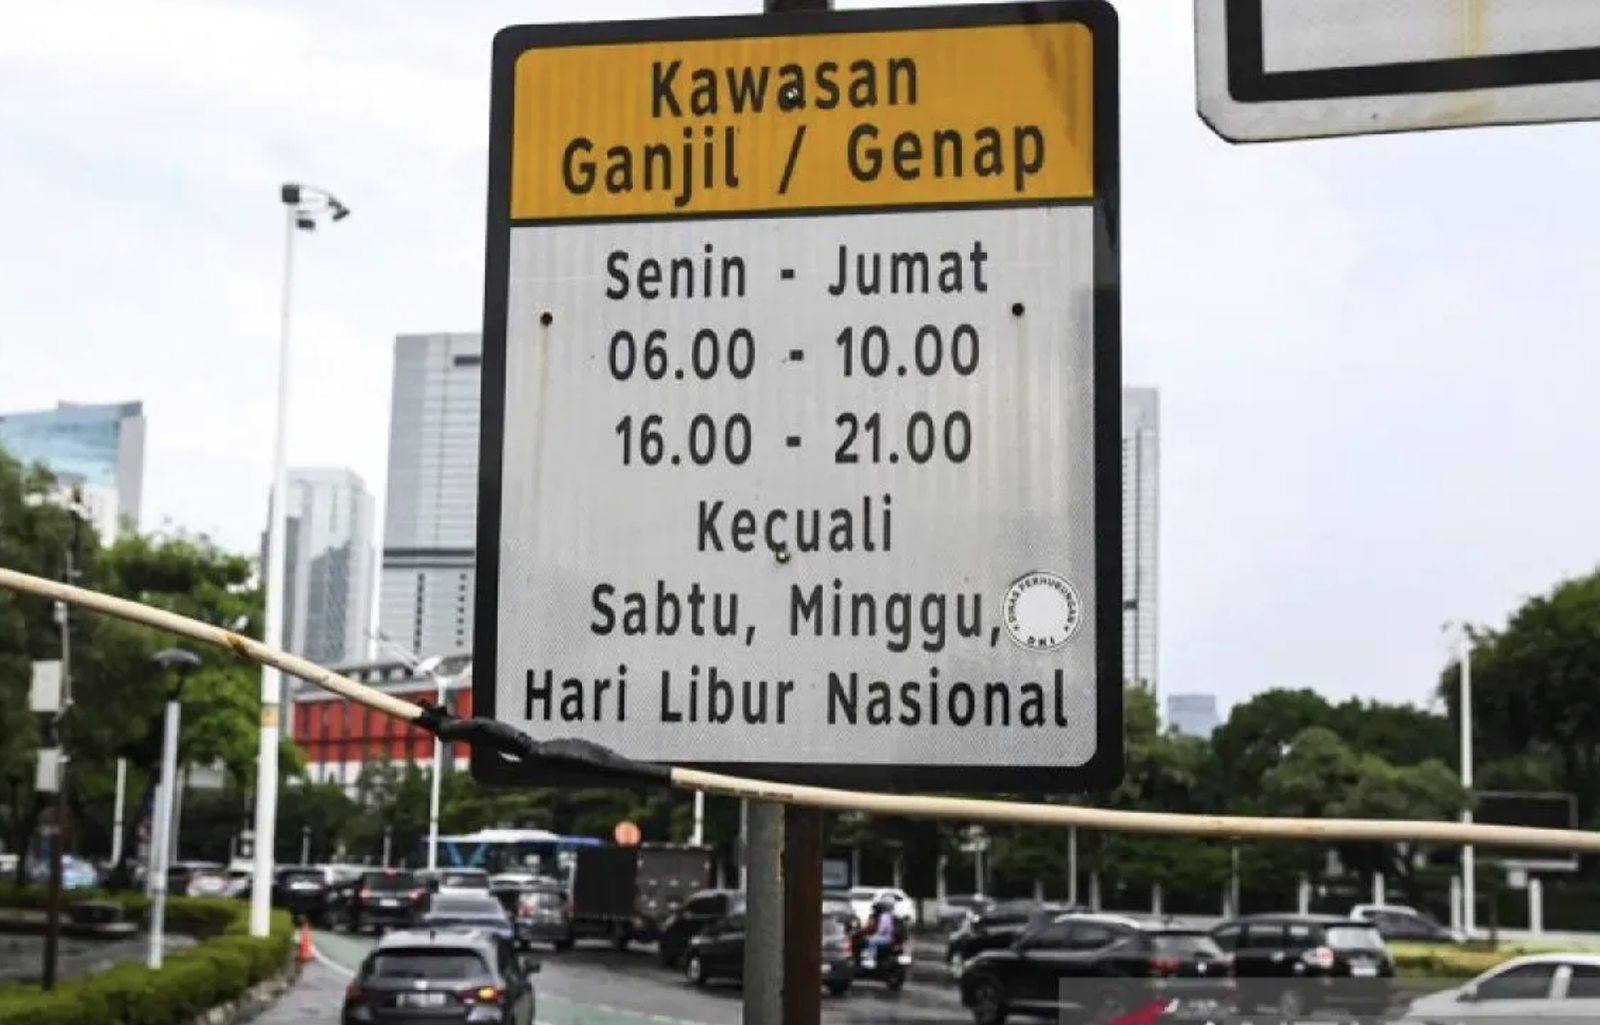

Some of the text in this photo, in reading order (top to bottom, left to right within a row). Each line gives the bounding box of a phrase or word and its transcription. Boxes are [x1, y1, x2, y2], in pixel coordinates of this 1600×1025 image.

[651, 57, 917, 118] Kawasan
[562, 122, 1045, 207] Ganjil / Genap
[606, 241, 988, 300] Senin - Jumat
[609, 324, 980, 381] 06.00 - 10.00
[616, 411, 972, 465] 16.00 - 21.00
[698, 493, 892, 553] Kecuali
[590, 578, 1001, 653] Sabtu, Minggu,
[525, 664, 1068, 728] Hari Libur Nasional
